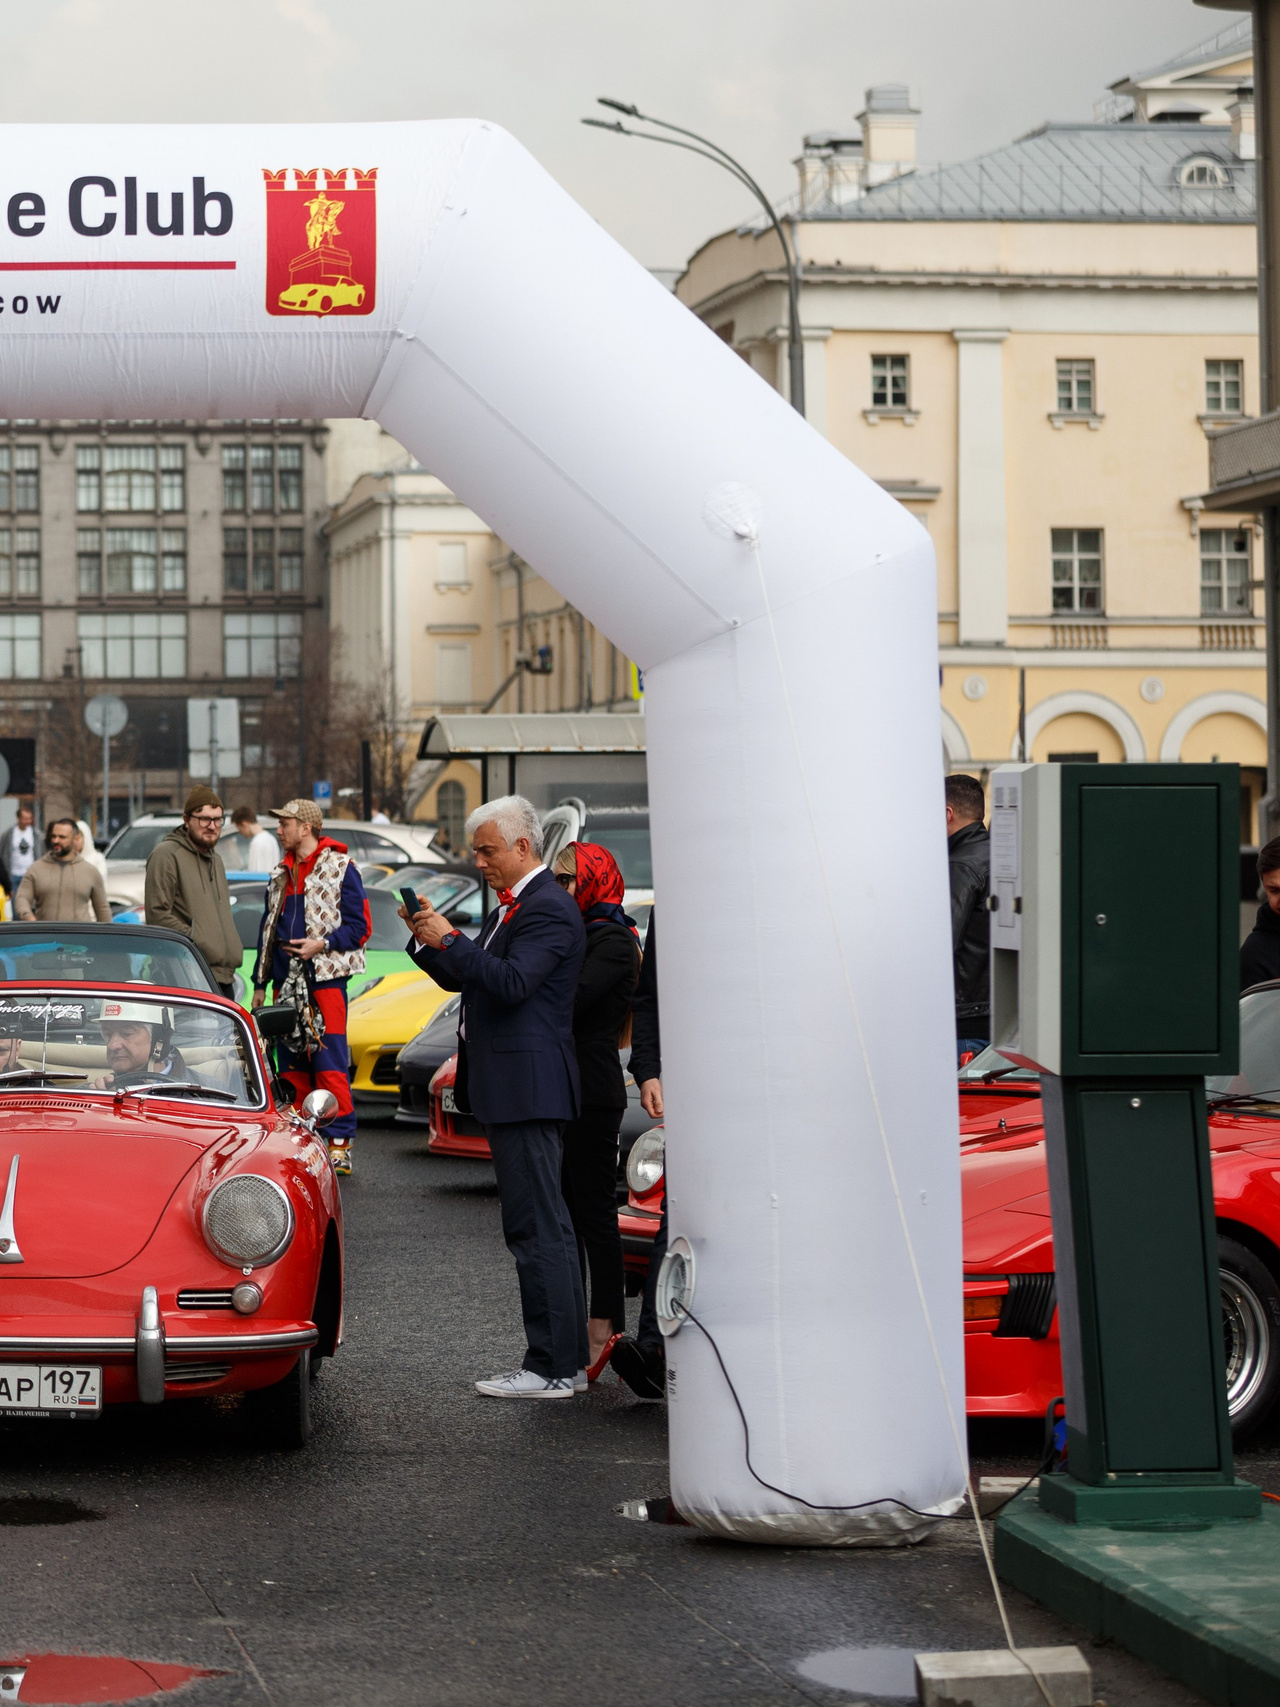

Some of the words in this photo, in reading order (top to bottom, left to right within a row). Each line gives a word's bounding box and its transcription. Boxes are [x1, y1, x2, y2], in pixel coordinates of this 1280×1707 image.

[68, 175, 234, 237] Club
[44, 1370, 91, 1395] 197
[53, 1395, 78, 1404] RUS
